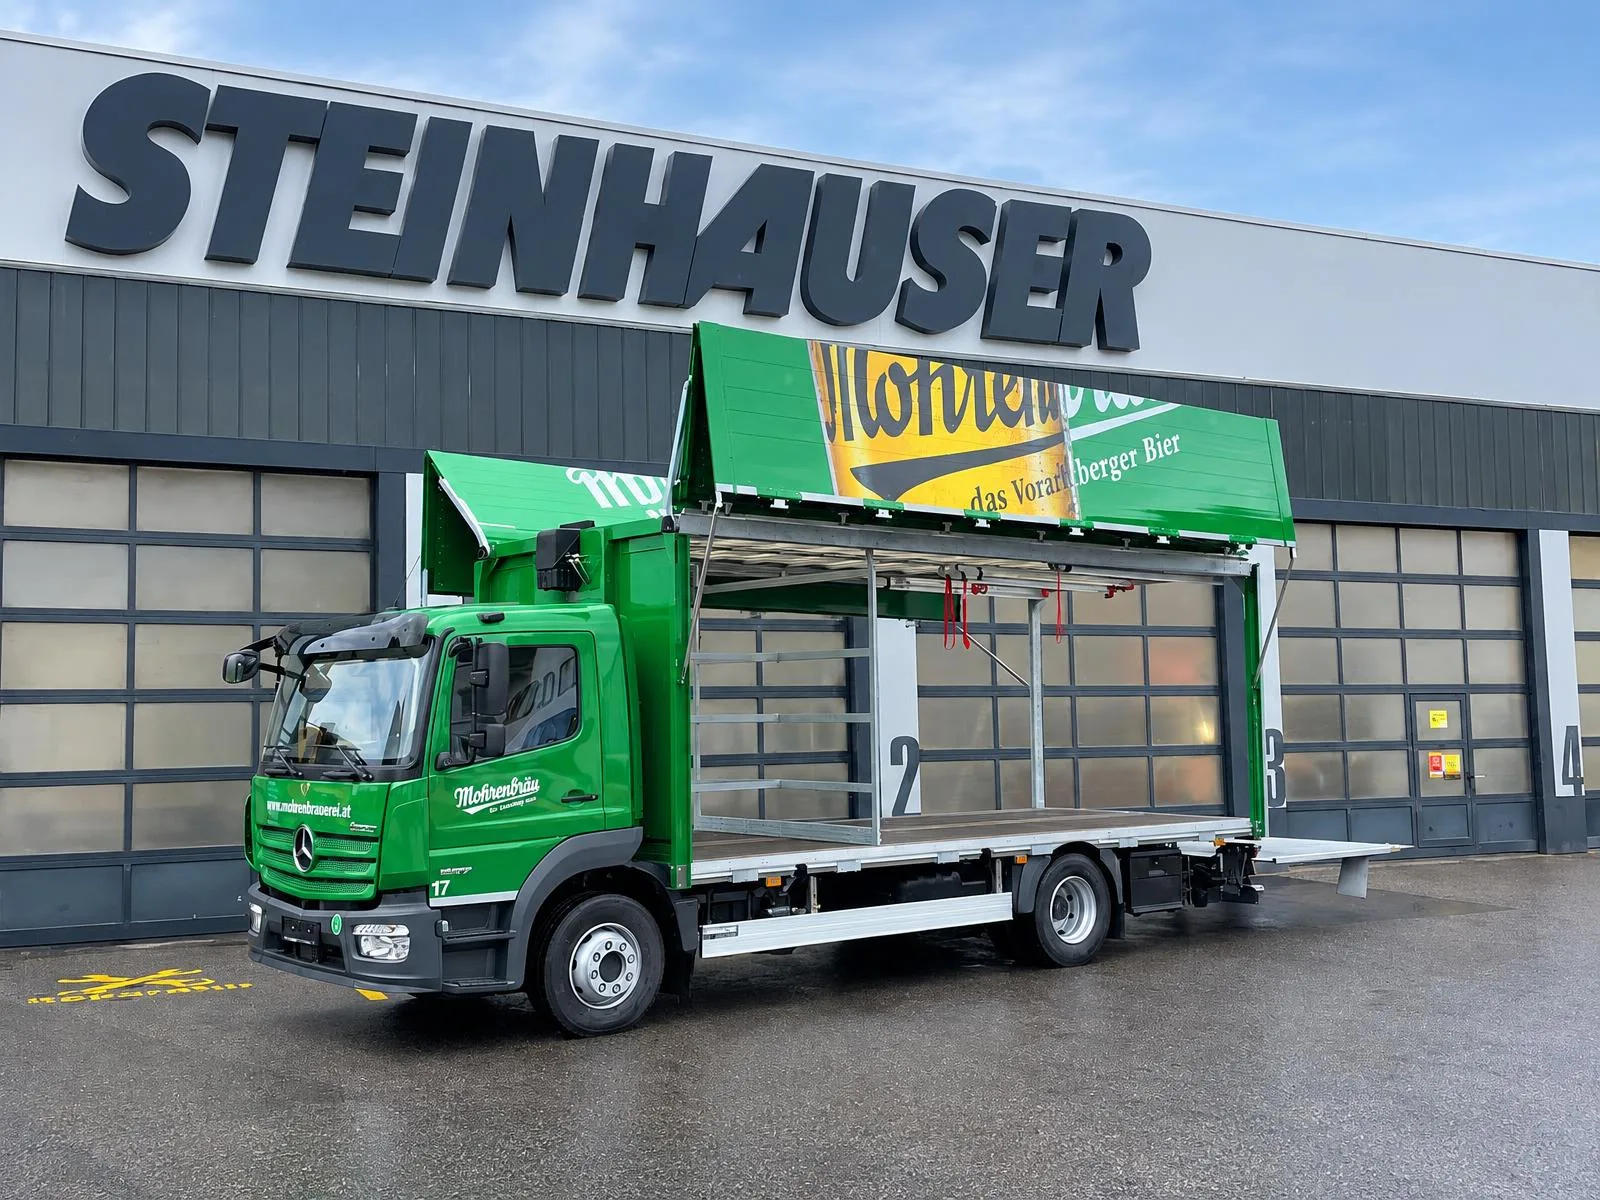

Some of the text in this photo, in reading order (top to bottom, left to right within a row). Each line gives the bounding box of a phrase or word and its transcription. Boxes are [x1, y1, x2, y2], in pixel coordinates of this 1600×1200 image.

[65, 73, 1152, 353] STEINHAUSER
[970, 486, 1008, 513] das
[1142, 432, 1181, 464] Bier
[453, 776, 541, 809] Mohrenbräu
[890, 735, 921, 817] 2
[1264, 728, 1286, 808] 3
[1561, 725, 1585, 797] 4
[266, 799, 352, 819] www.mohrenbrauerei.at
[431, 879, 451, 897] 17
